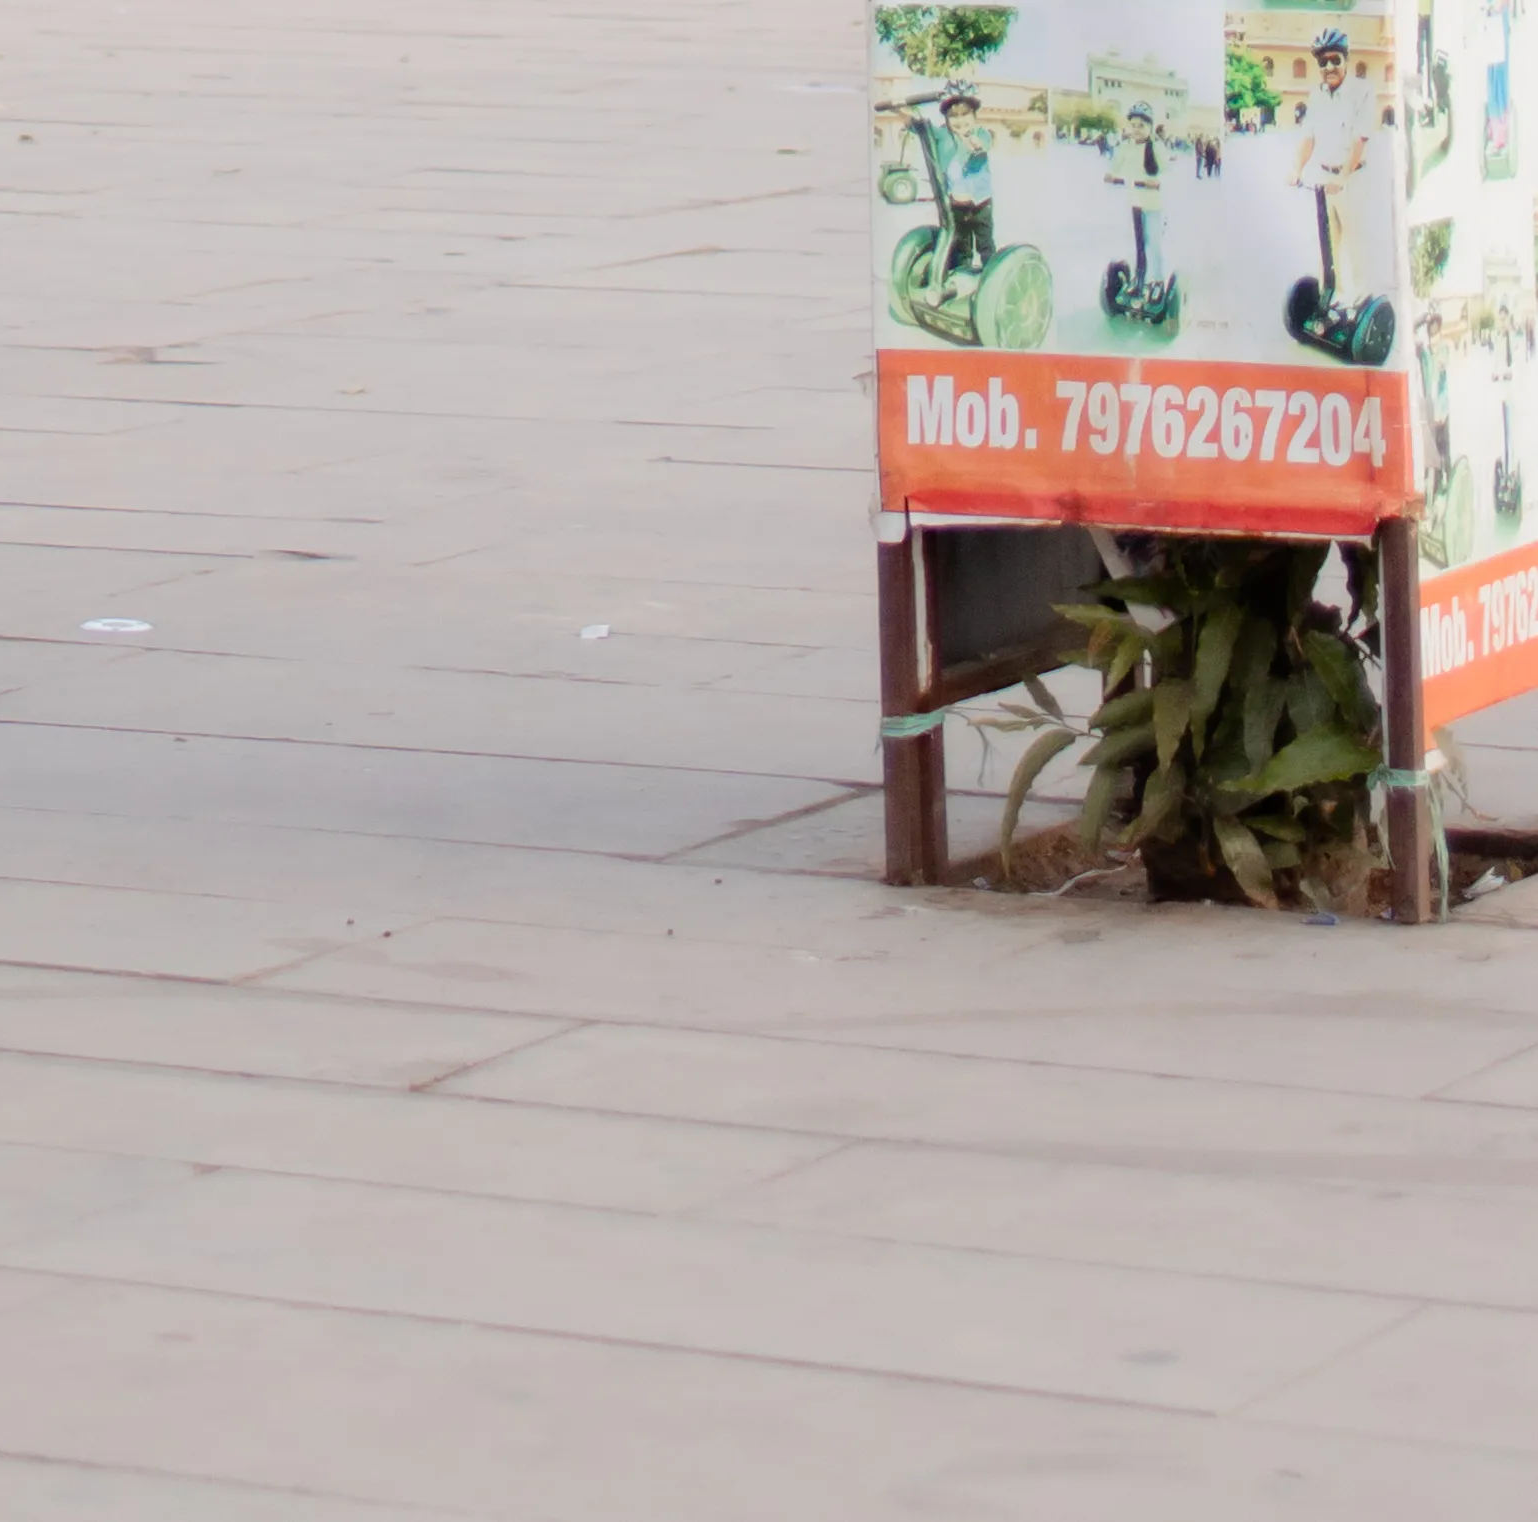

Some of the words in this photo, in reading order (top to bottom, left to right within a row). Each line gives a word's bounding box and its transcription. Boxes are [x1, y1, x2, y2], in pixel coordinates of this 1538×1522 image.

[906, 375, 1037, 450] Mob.
[1055, 380, 1387, 468] 7976267204
[1419, 595, 1474, 680] Mob.
